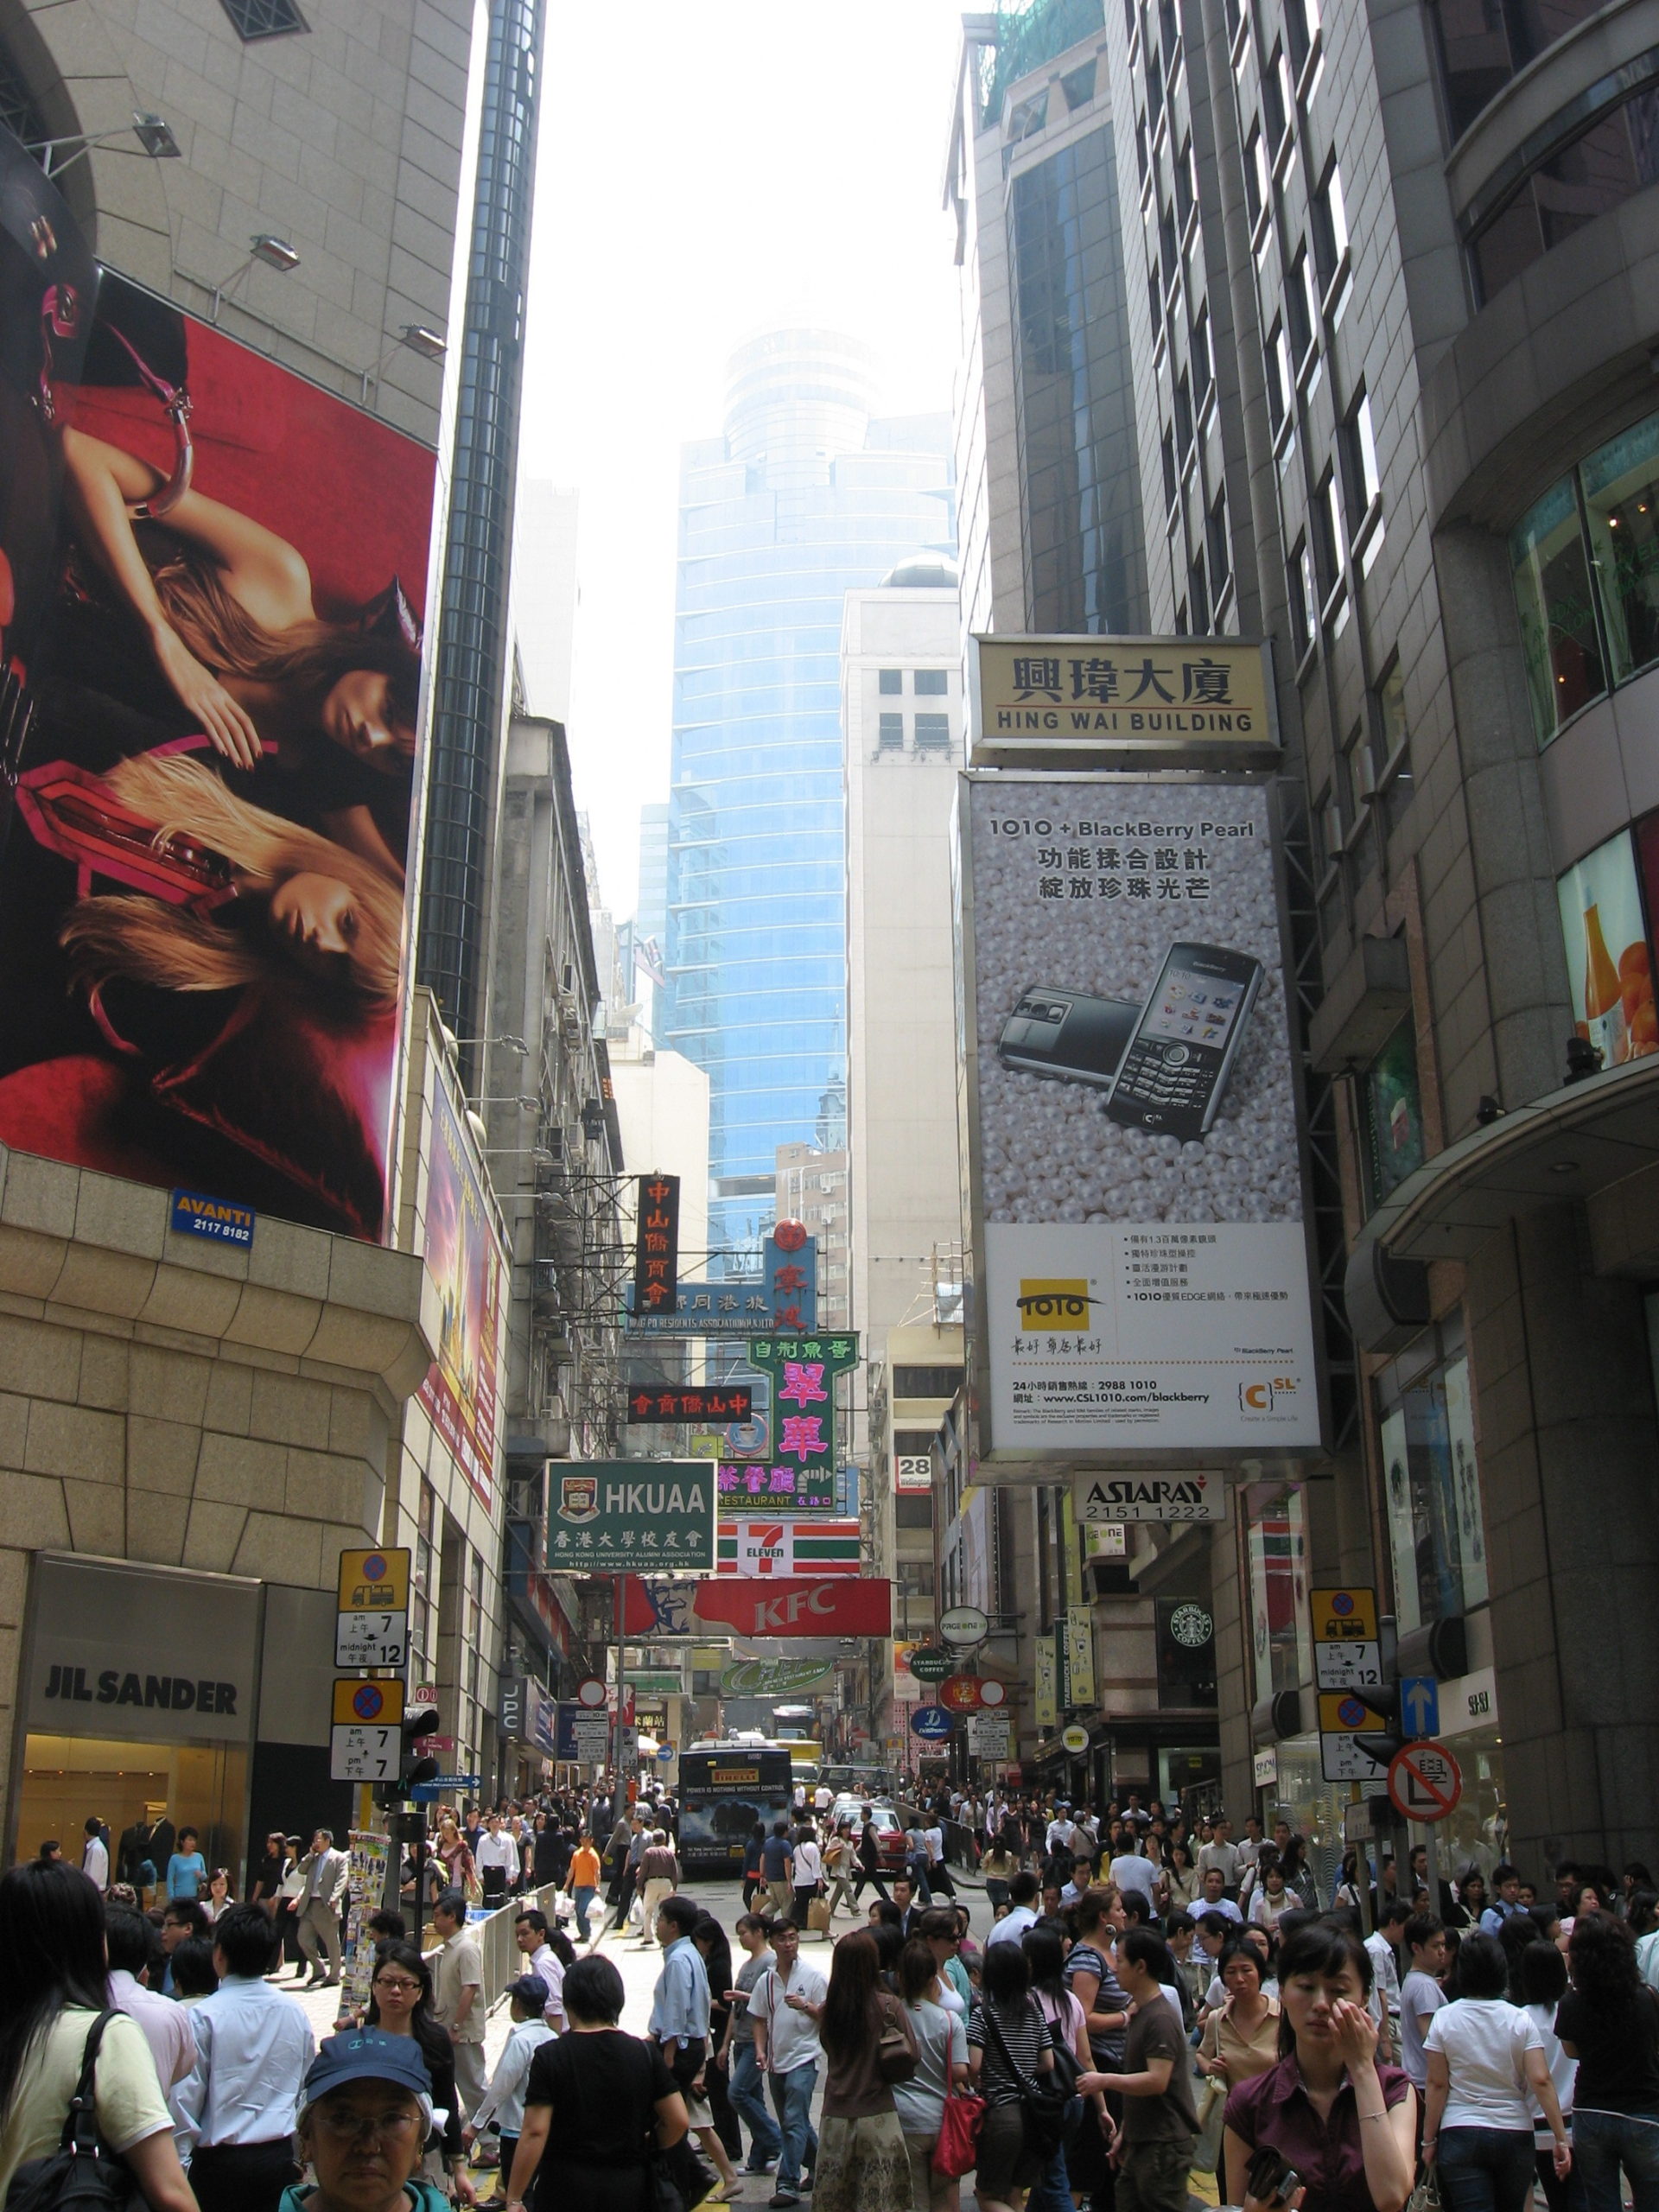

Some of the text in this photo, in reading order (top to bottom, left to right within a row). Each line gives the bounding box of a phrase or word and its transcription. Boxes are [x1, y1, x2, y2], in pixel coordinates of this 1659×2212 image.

[1013, 658, 1233, 705] 興瑋大廈
[997, 711, 1252, 732] HING WAI BUILDING
[990, 819, 1052, 836] 1010
[1078, 821, 1194, 840] BlackBerry
[1201, 822, 1253, 837] Pearl
[1038, 849, 1209, 870] 功能揉合設計
[1039, 876, 1210, 899] 綻放珍珠光芒
[177, 1196, 251, 1227] AVANTI
[194, 1218, 250, 1241] 2117 8182
[645, 1180, 671, 1306] 中山僑商會
[1098, 1381, 1126, 1390] 2988
[1131, 1381, 1156, 1389] 1010
[1044, 1391, 1210, 1404] www.CSL1010.com/blackberry
[779, 1361, 829, 1462] 翠華
[900, 1459, 930, 1474] 28
[606, 1482, 706, 1514] HKUAA
[1086, 1481, 1207, 1503] ASIARAY
[1086, 1506, 1210, 1519] 2151 1222
[554, 1529, 702, 1548] 香港大學校友會
[753, 1583, 836, 1633] KFC
[349, 1624, 369, 1633] 上午
[381, 1616, 392, 1633] 7
[1177, 1632, 1207, 1645] COFFEE
[340, 1643, 400, 1662] midnight 12
[348, 1654, 367, 1663] 午夜
[1327, 1652, 1345, 1661] 上午
[1355, 1645, 1366, 1659] 7
[1358, 1670, 1377, 1684] 12
[45, 1665, 238, 1715] JIL SANDER
[346, 1738, 365, 1747] 上午
[378, 1730, 388, 1747] 7
[345, 1767, 365, 1777] 下午
[376, 1759, 387, 1777] 7
[1366, 1761, 1376, 1776] 7
